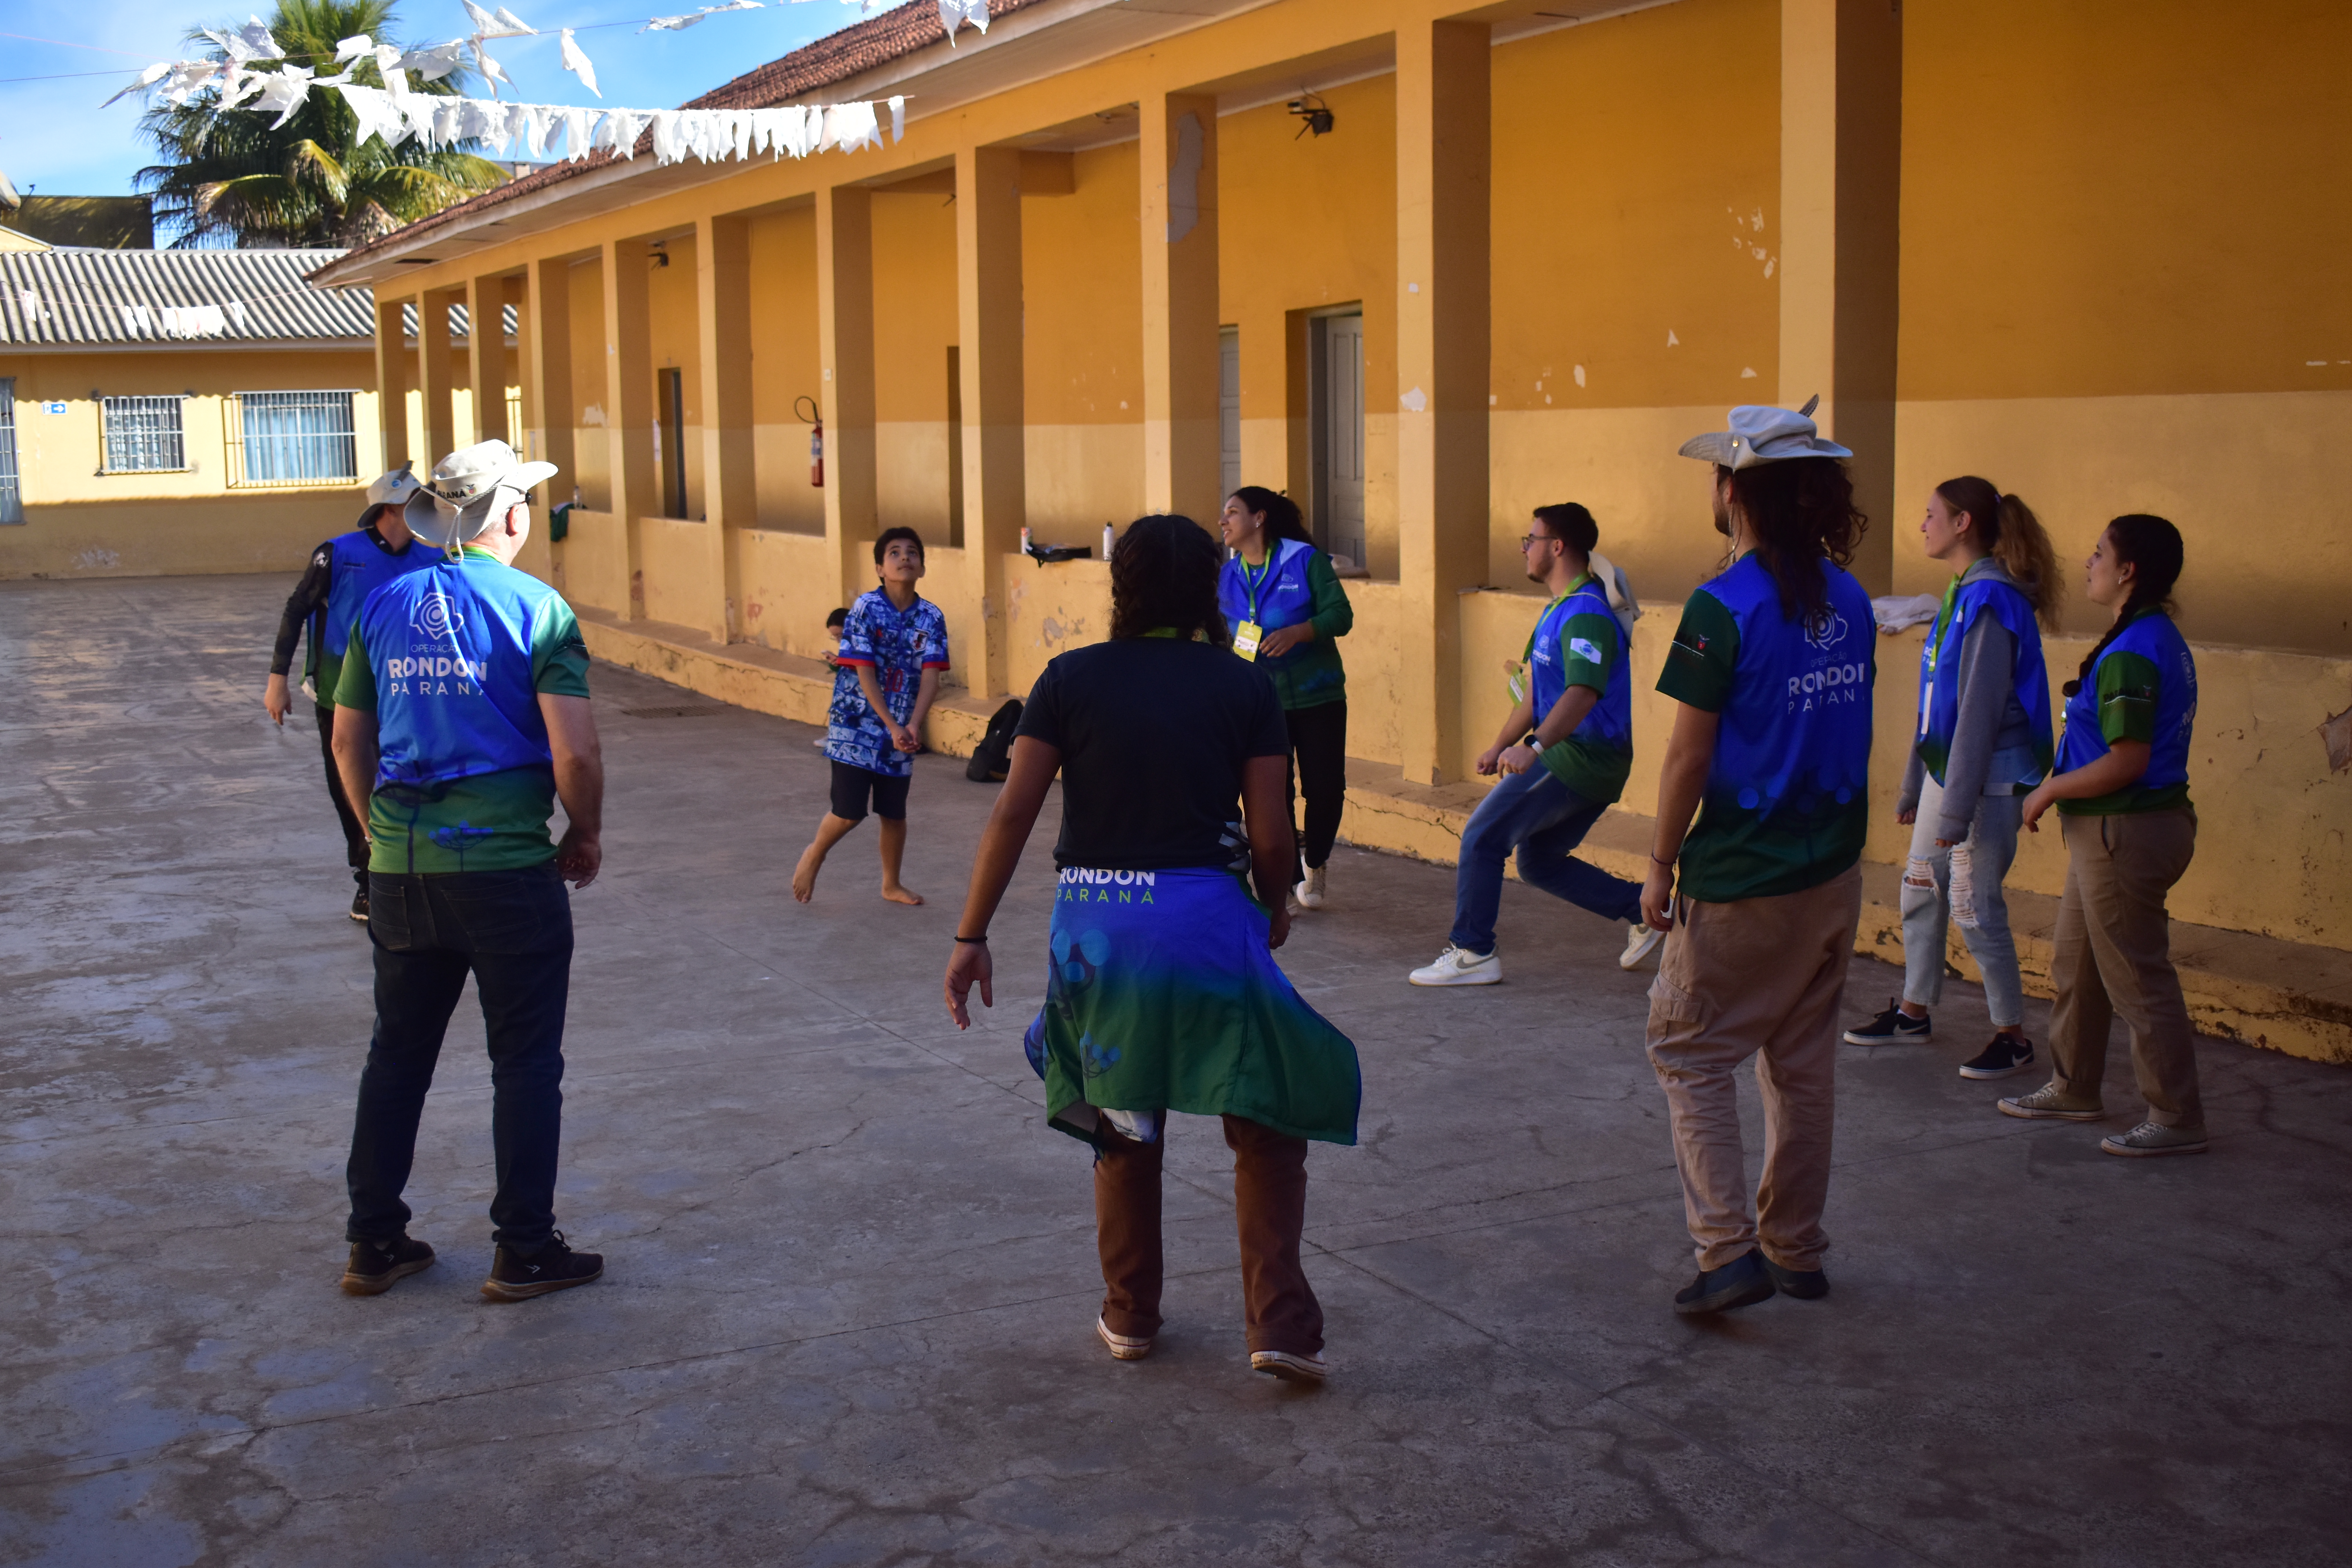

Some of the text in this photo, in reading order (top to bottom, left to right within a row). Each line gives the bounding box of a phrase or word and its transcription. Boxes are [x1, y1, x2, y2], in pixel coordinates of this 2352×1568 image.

[388, 657, 487, 681] RONDON
[884, 667, 903, 692] 10
[1059, 867, 1155, 886] RONDON
[1057, 888, 1154, 904] PARANÁ
